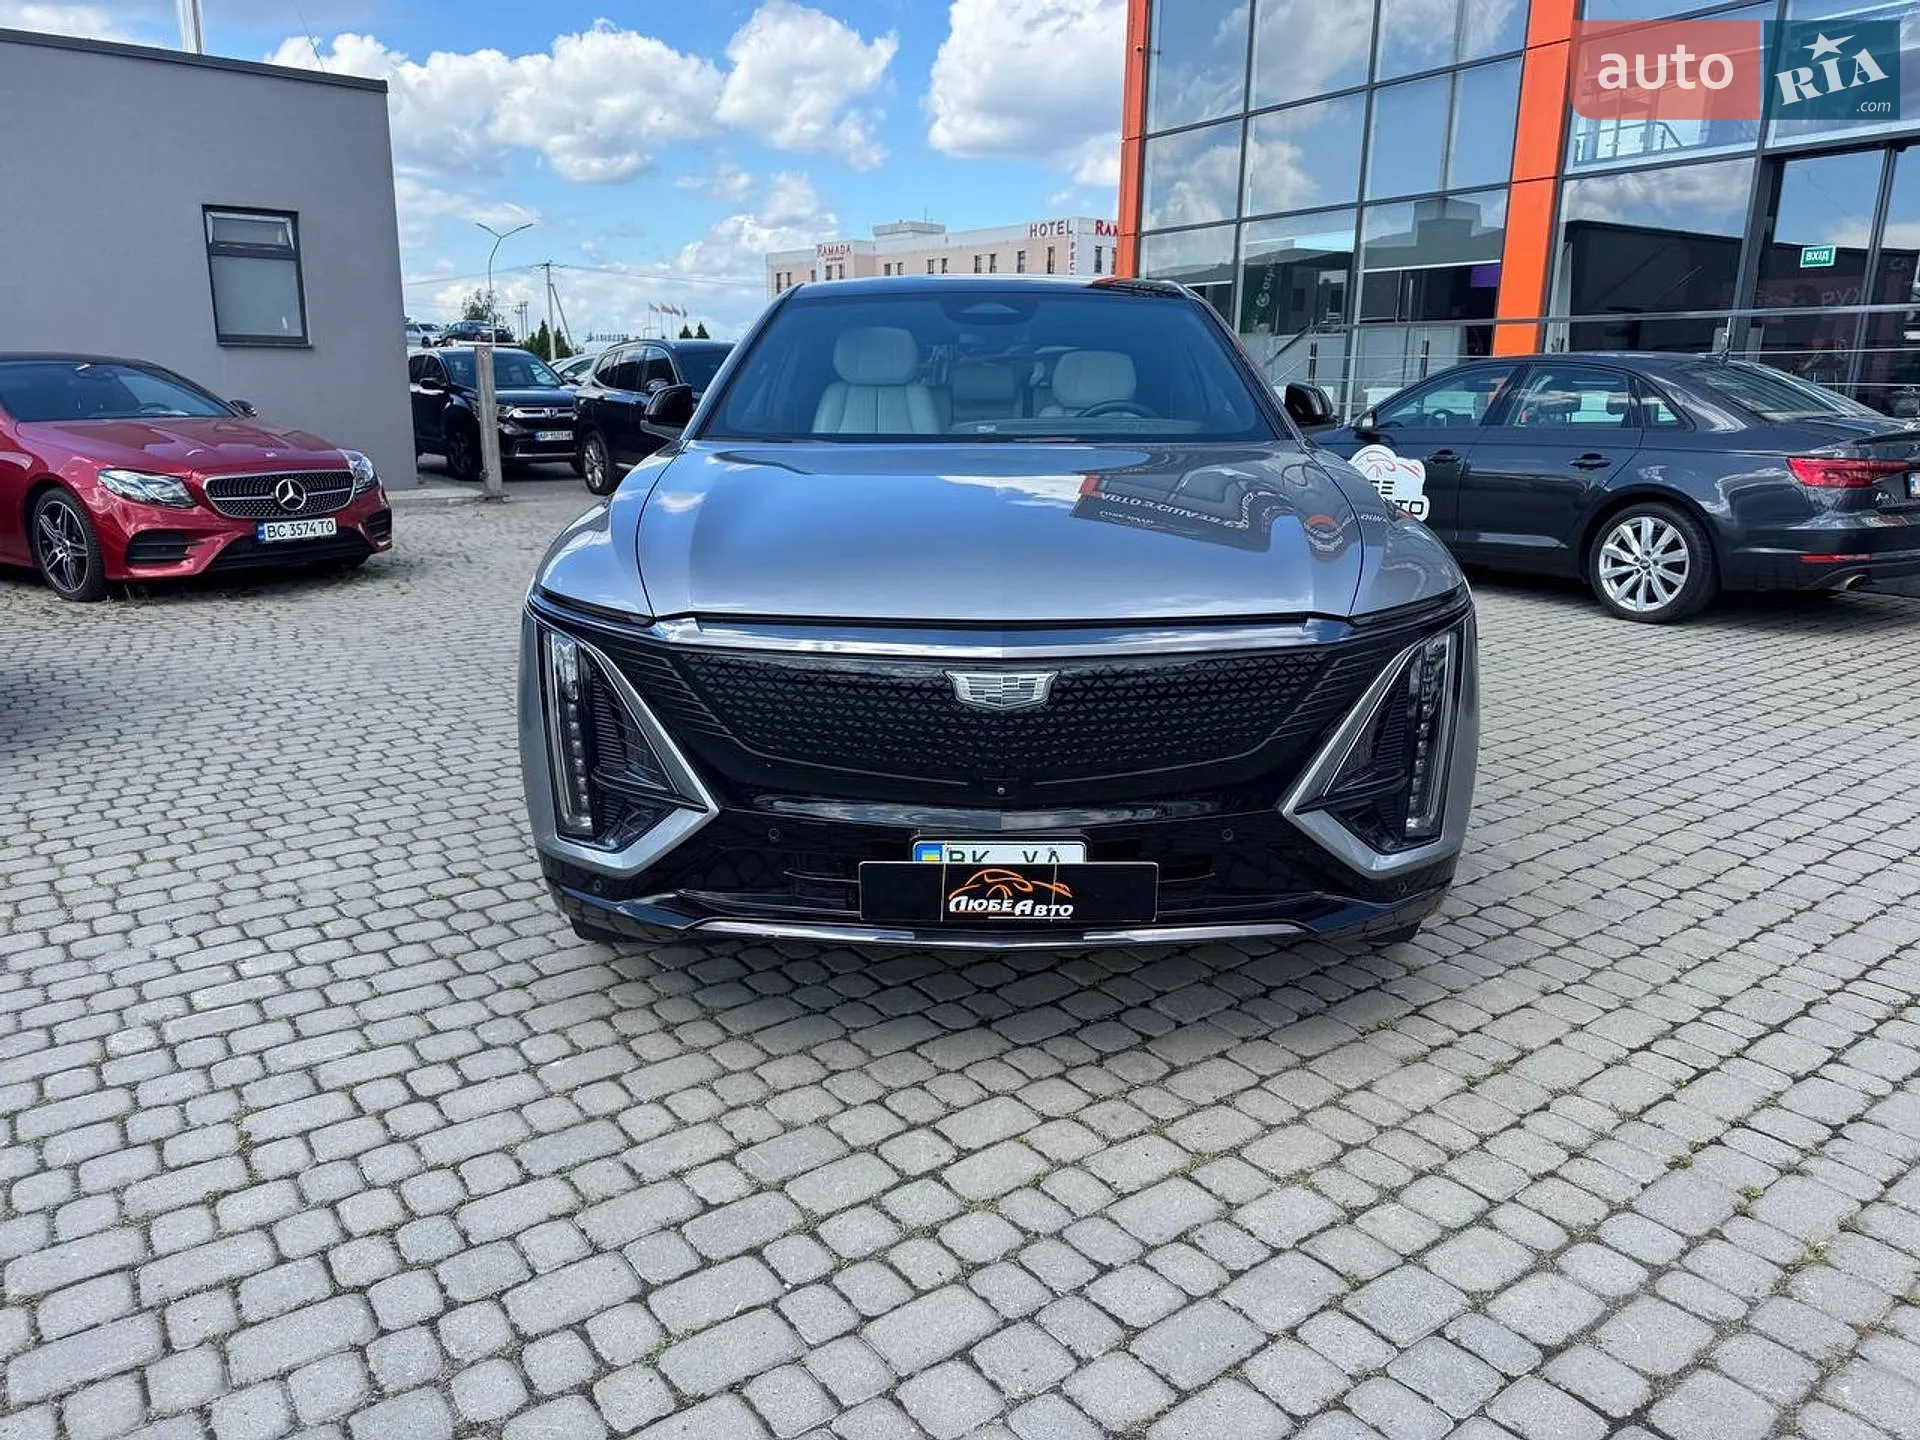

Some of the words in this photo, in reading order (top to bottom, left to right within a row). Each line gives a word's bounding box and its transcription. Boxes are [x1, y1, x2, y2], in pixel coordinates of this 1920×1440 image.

[1030, 220, 1073, 237] HOTEL
[267, 524, 287, 538] BC
[289, 522, 317, 536] 3574
[319, 520, 334, 535] TO
